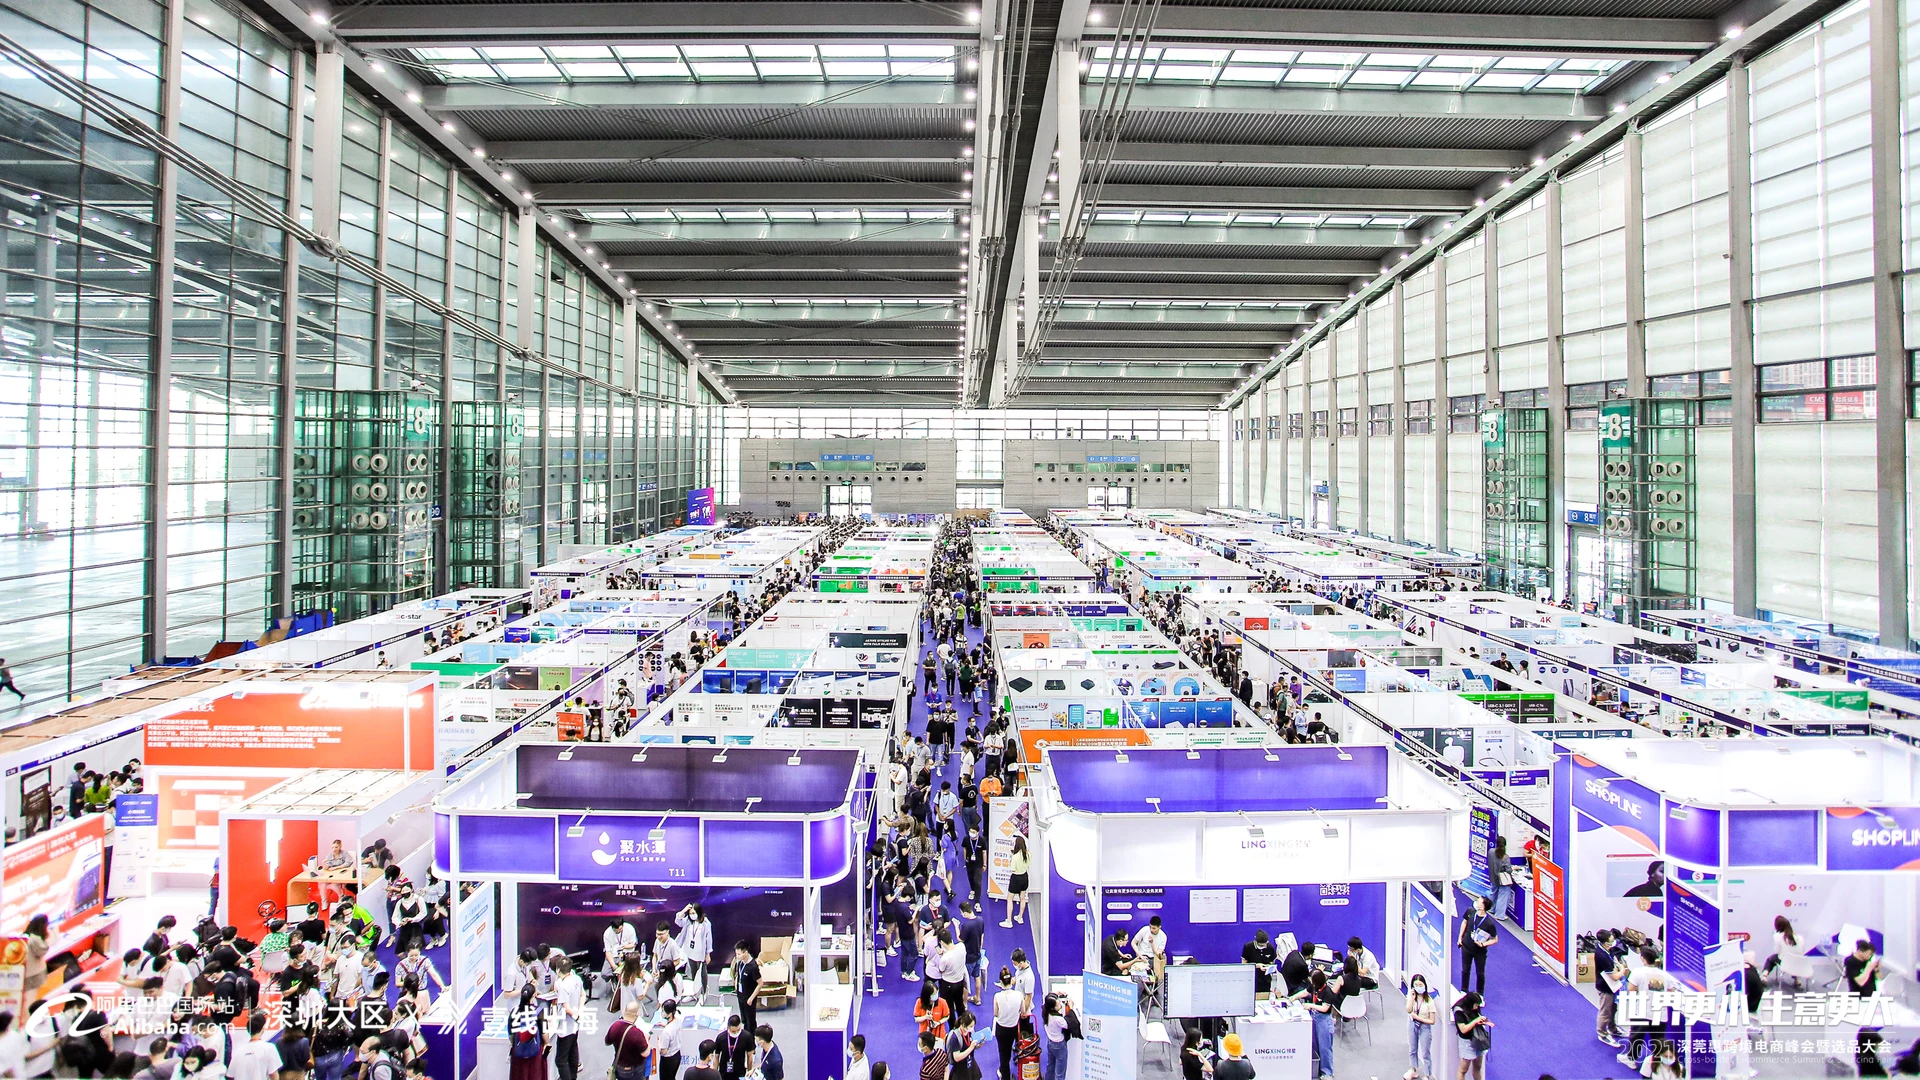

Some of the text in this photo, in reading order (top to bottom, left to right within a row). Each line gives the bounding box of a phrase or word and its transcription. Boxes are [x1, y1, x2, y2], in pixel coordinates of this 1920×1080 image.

[413, 406, 426, 434] 8
[511, 414, 519, 437] 8
[1487, 420, 1498, 442] 8
[1608, 413, 1622, 440] 8
[1585, 779, 1642, 820] SHOPLINE
[668, 868, 686, 877] T11
[1087, 979, 1121, 992] LINGXING
